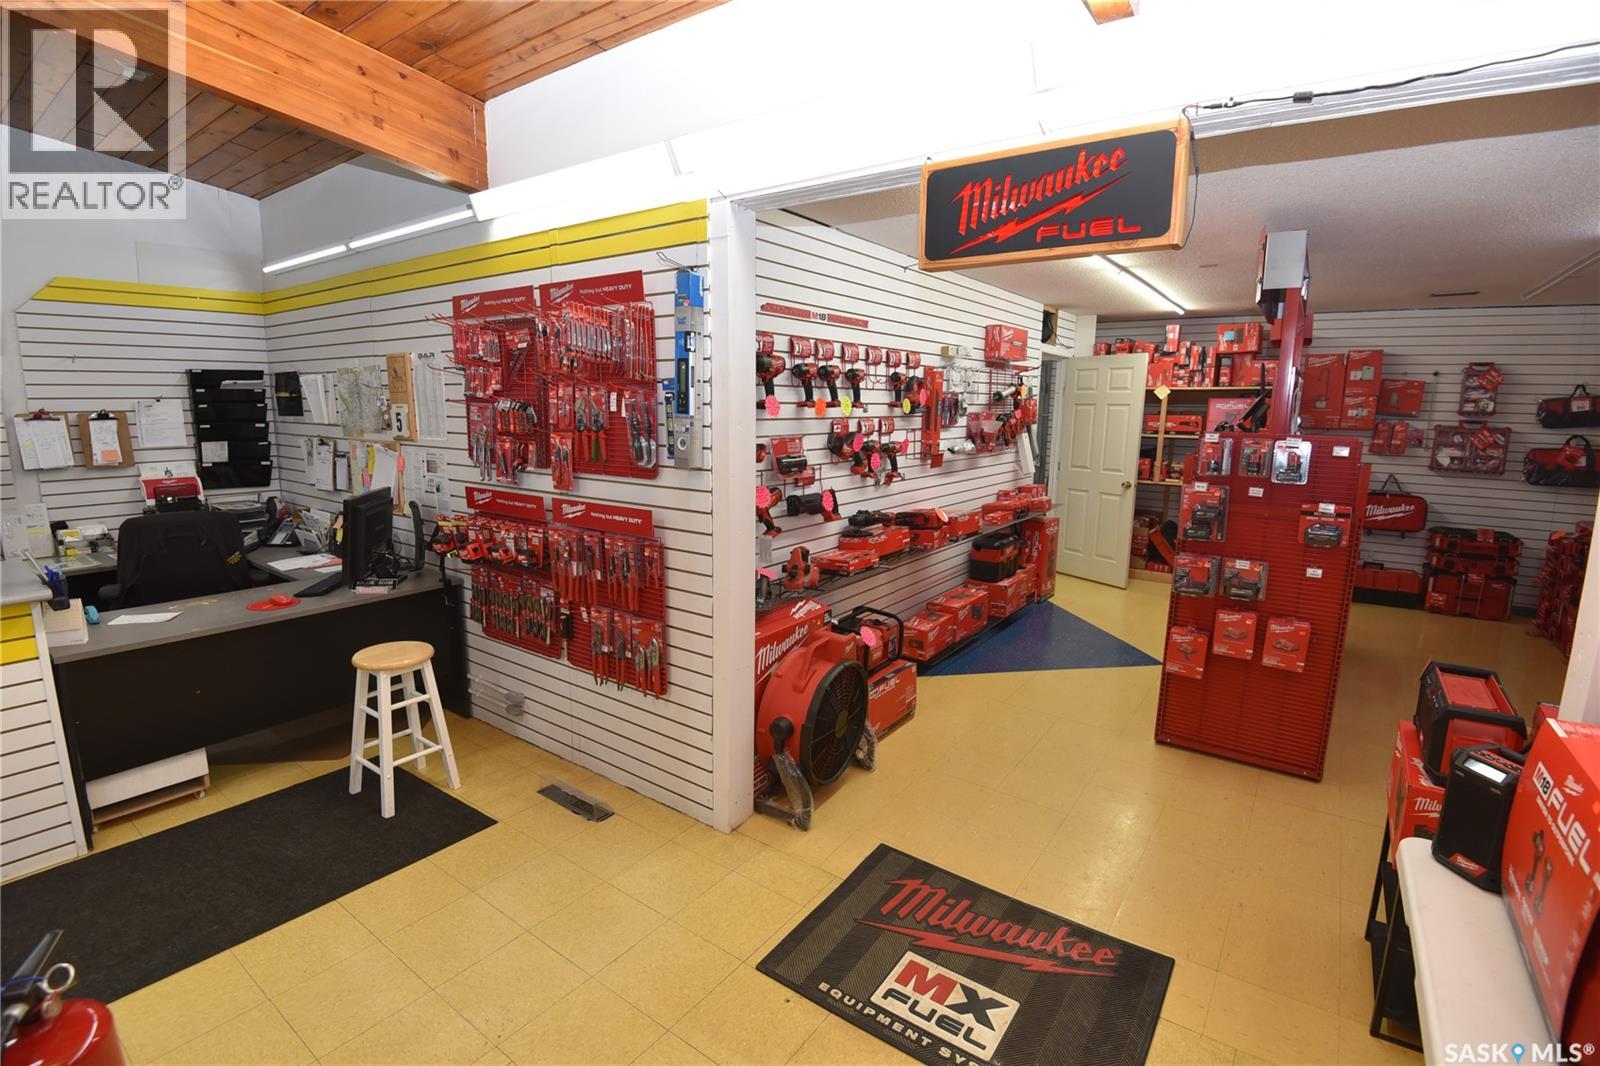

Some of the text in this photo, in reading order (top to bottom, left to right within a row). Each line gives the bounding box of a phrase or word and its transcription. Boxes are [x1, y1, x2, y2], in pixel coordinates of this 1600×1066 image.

[951, 147, 1128, 236] Milwaukee
[1035, 216, 1141, 243] FUEL
[812, 312, 827, 321] M18
[395, 412, 403, 432] 5
[1365, 503, 1416, 517] Milwaukee
[755, 624, 808, 675] Milwaukee
[1547, 787, 1591, 875] FUEL
[880, 879, 1119, 967] Milwaukee
[818, 981, 932, 1047] EQUIPMENT
[881, 987, 988, 1051] FUEL
[894, 959, 1009, 1032] MX
